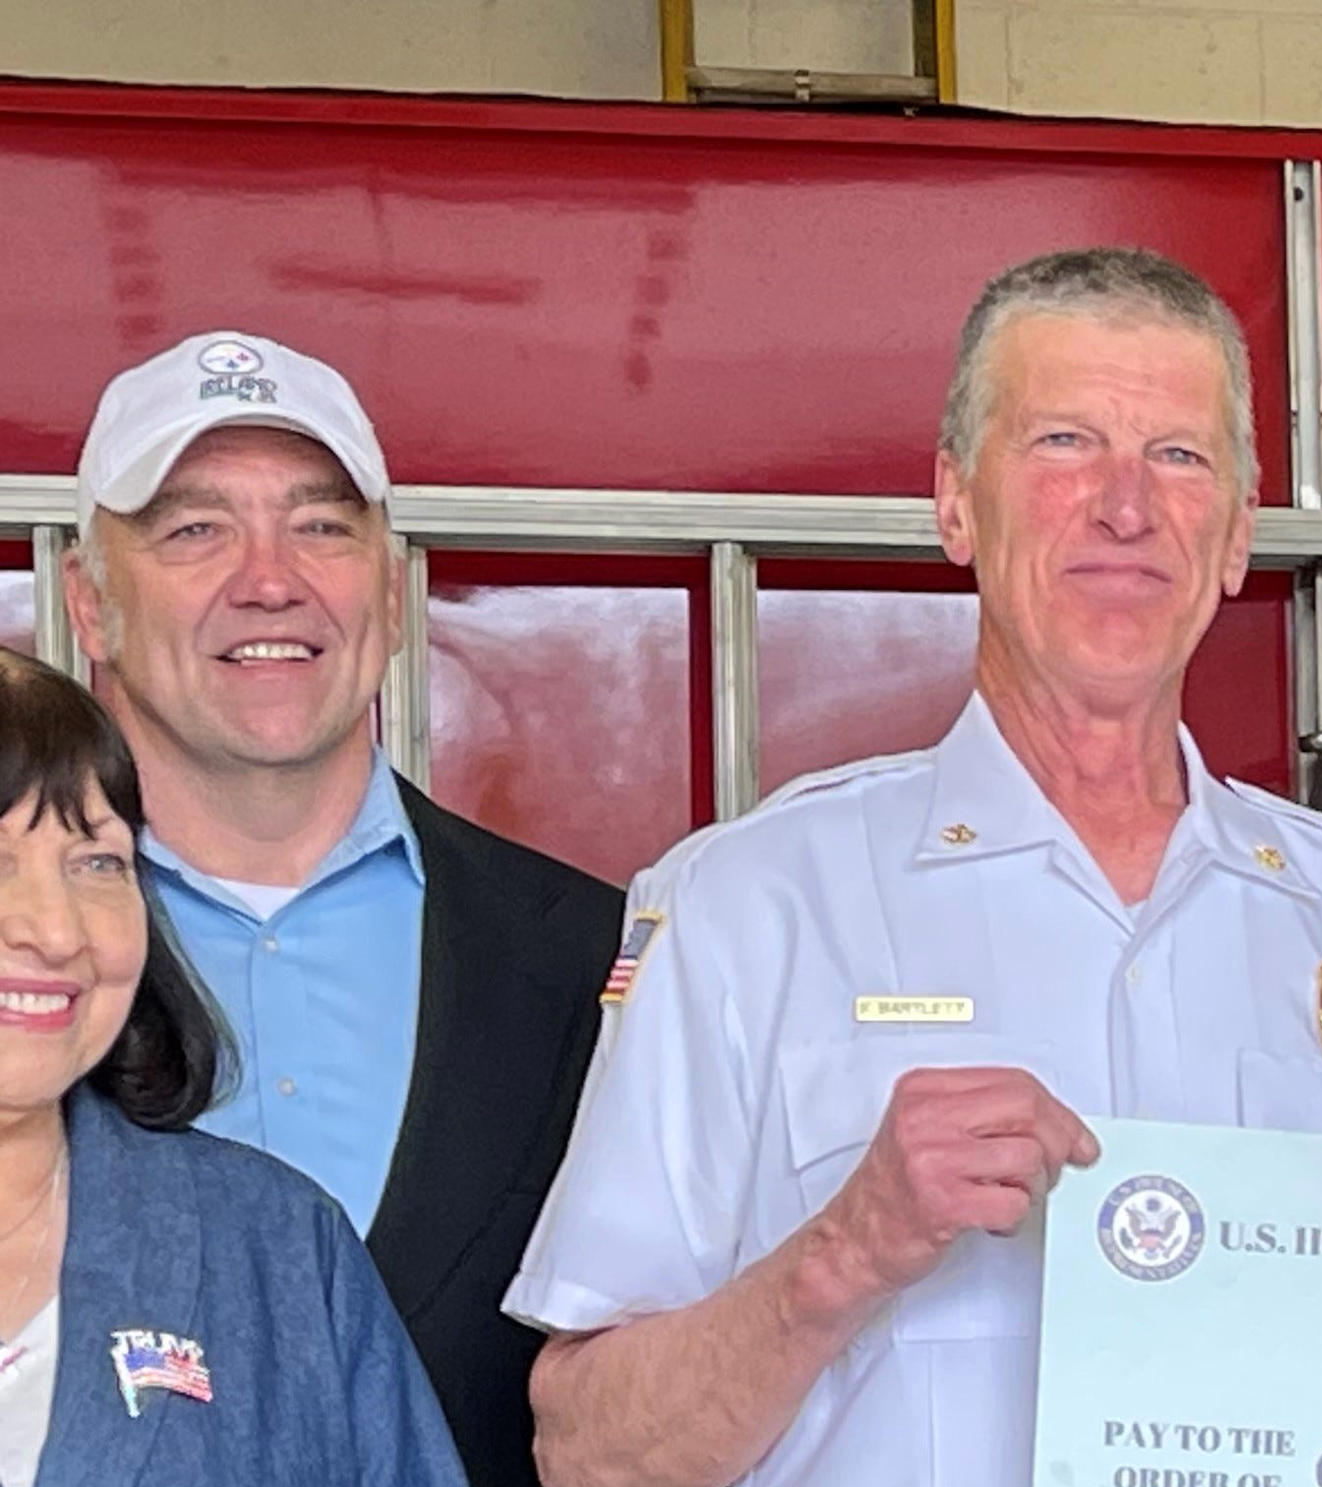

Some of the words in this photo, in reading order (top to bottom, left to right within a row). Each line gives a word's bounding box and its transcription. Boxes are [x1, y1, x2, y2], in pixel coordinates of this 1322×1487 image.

[1219, 1220, 1287, 1254] U.S.
[1104, 1420, 1168, 1449] PAY
[1174, 1424, 1222, 1453] TO
[1227, 1427, 1296, 1457] THE
